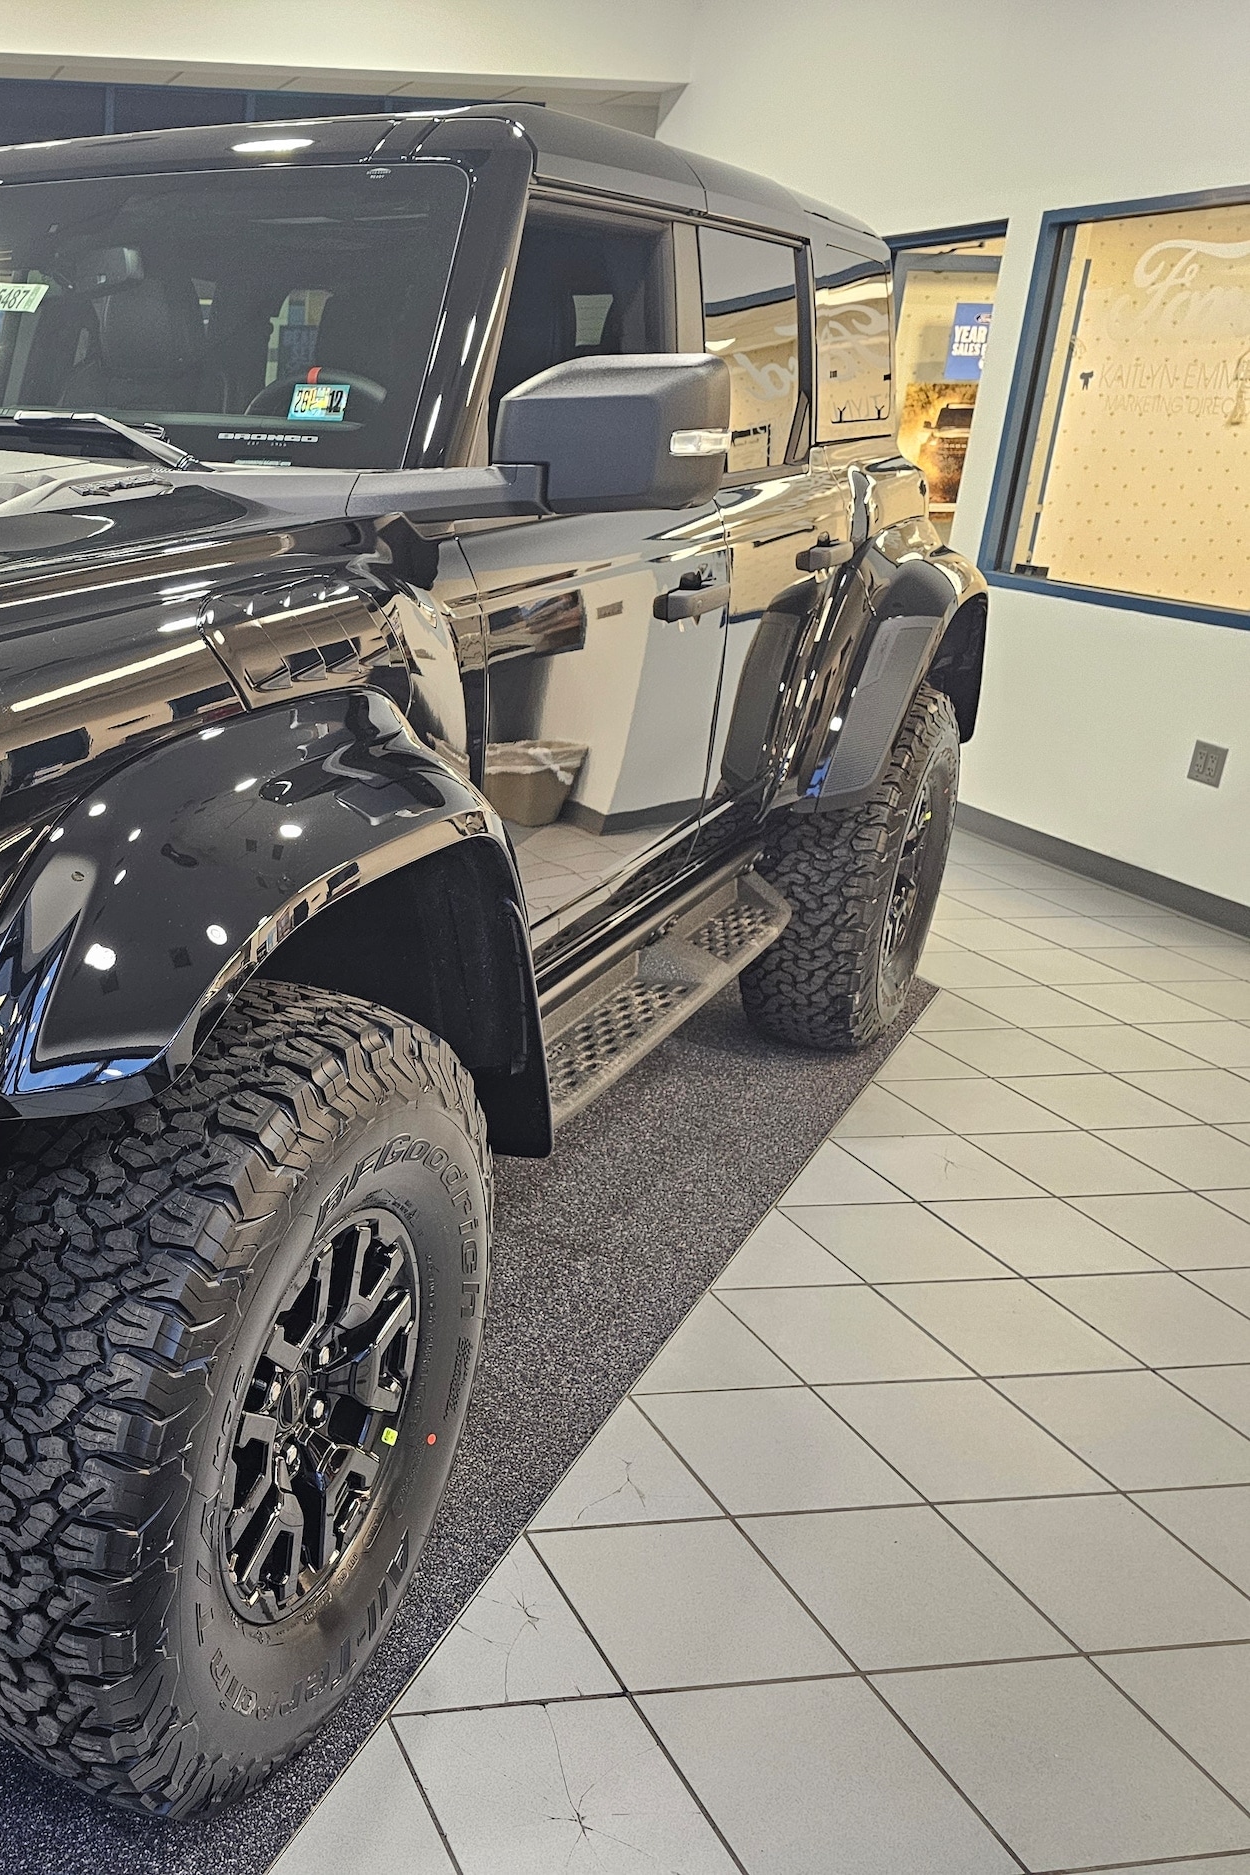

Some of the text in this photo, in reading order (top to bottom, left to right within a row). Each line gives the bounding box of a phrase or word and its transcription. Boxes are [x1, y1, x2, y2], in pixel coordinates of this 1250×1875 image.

[954, 325, 988, 343] YEAR
[951, 343, 981, 357] SALES
[1100, 363, 1178, 390] KAITLYN
[1104, 395, 1184, 415] MARKETING
[218, 432, 319, 443] BRONCO
[314, 1132, 480, 1320] BFGoodrich
[210, 1524, 410, 1722] All-Terrain
